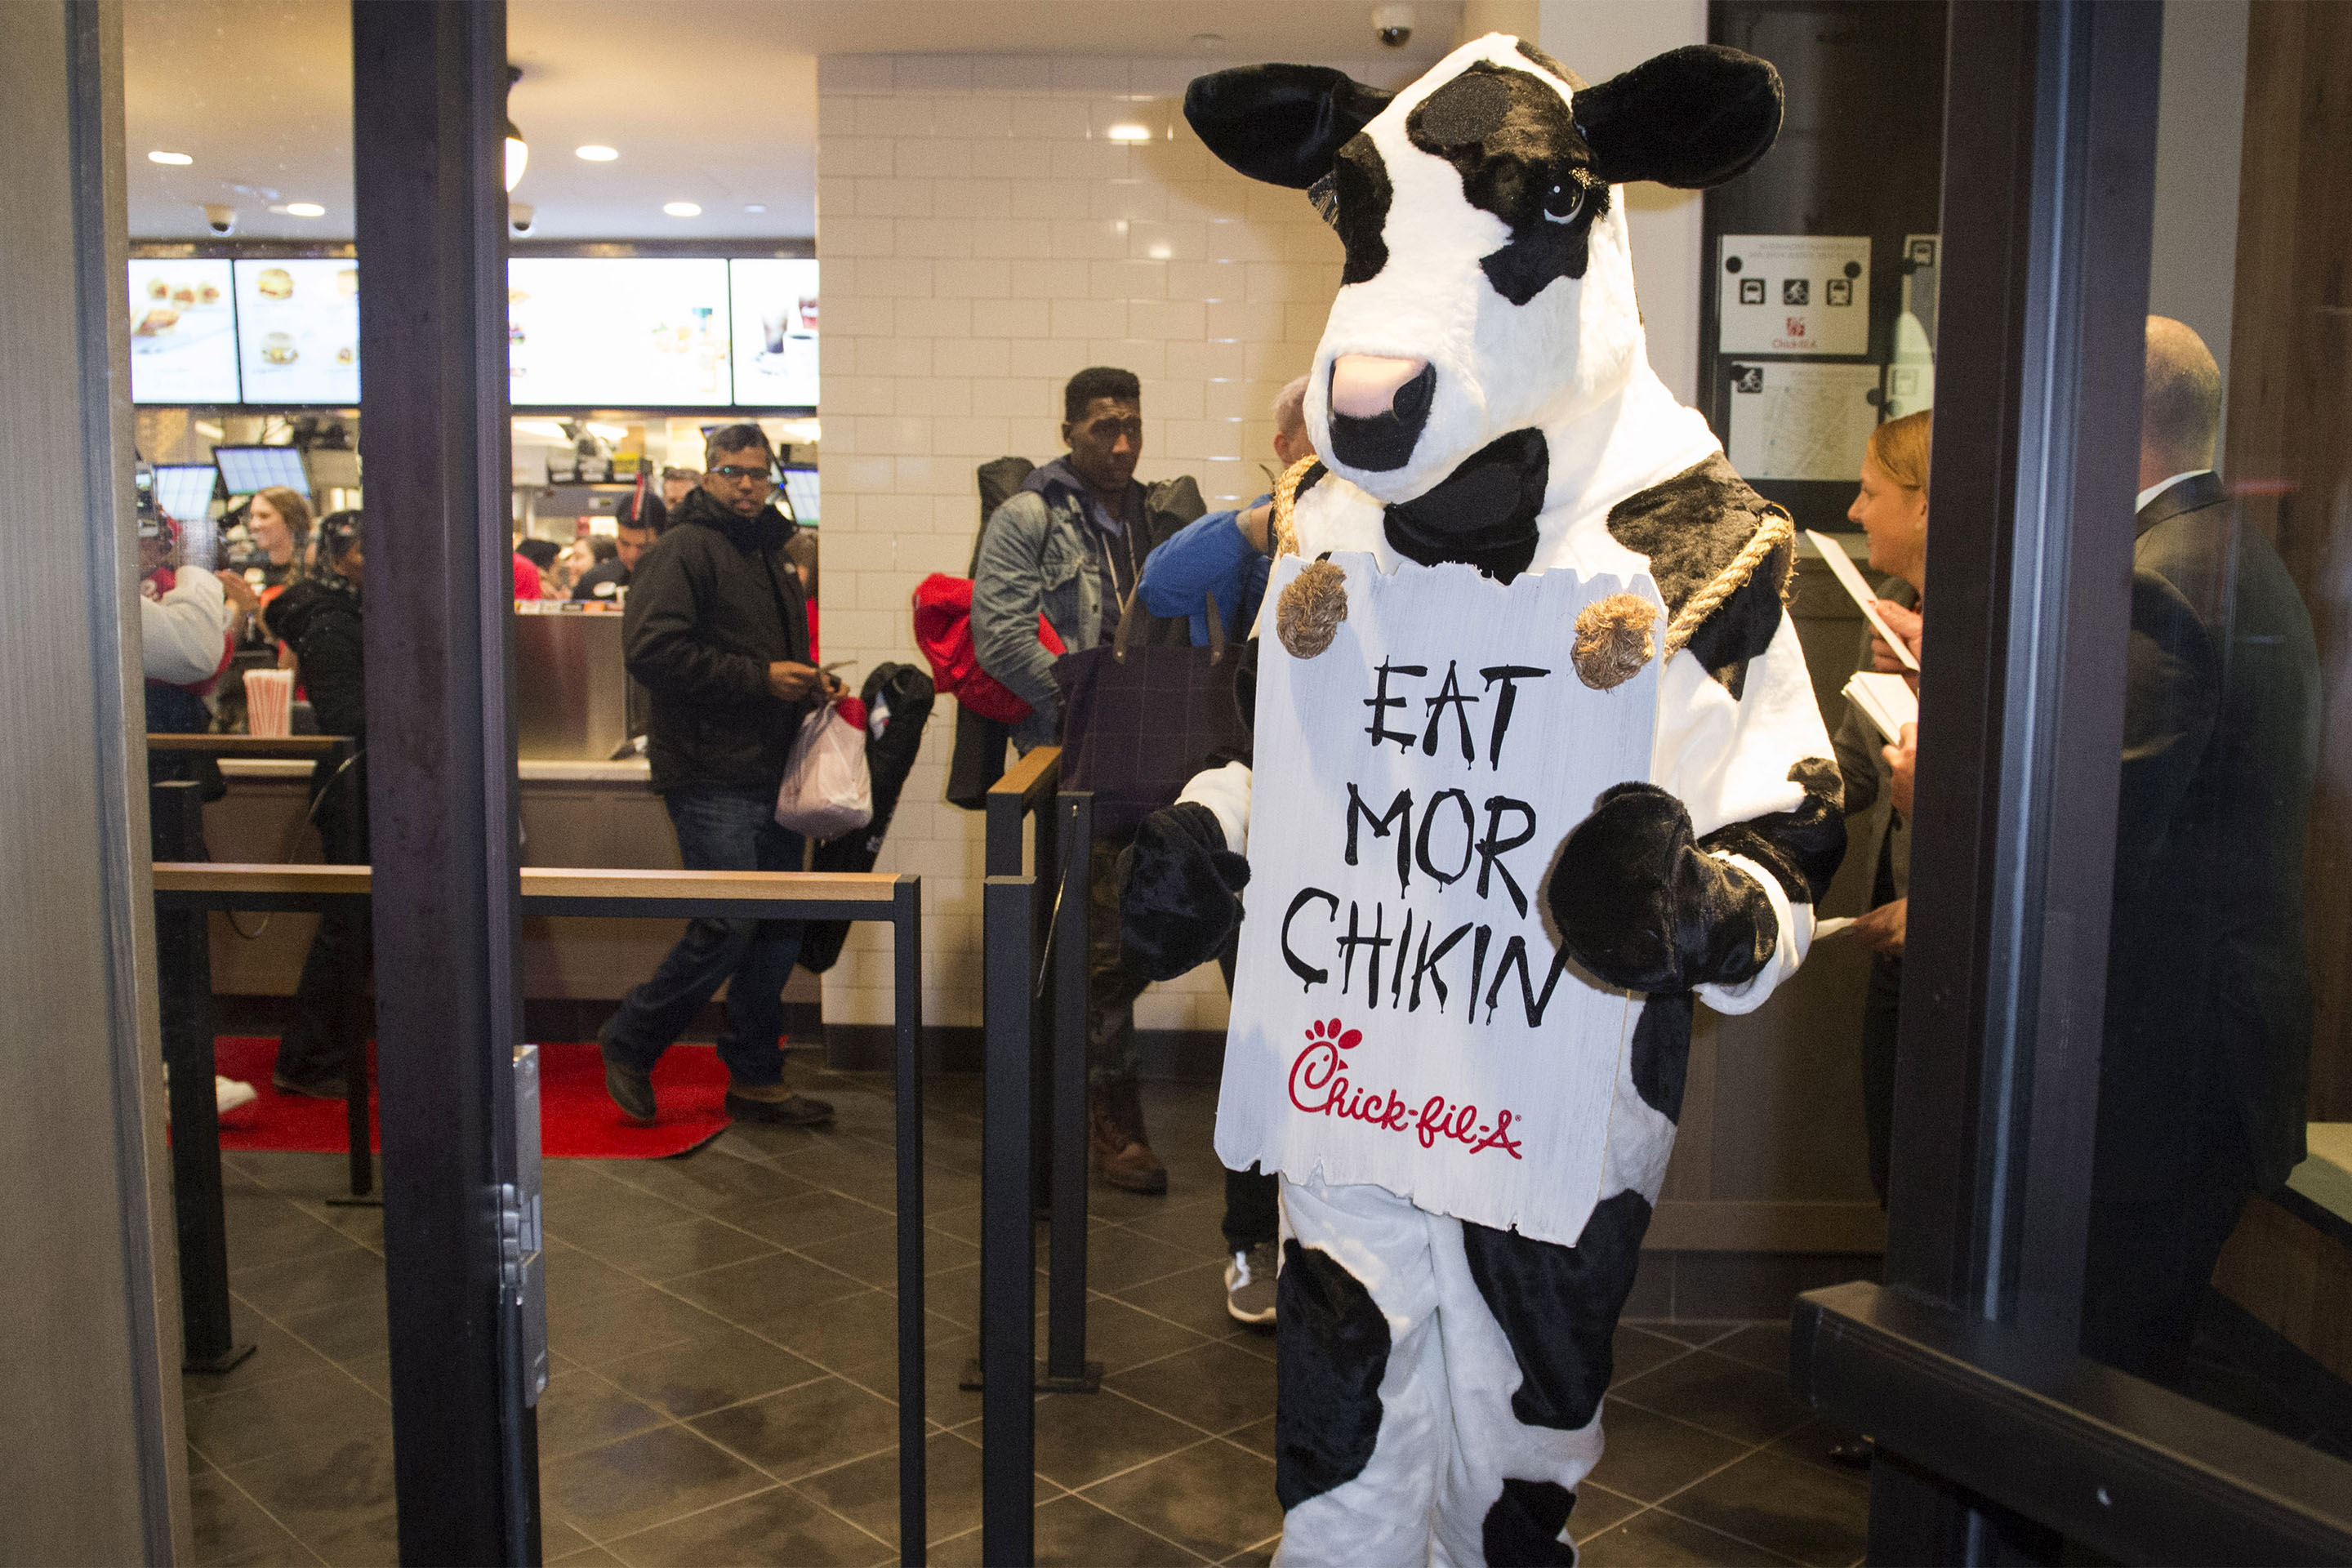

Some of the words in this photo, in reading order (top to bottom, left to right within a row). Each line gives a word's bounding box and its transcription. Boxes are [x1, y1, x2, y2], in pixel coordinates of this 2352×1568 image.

[1363, 654, 1551, 772] EAT
[1345, 782, 1536, 920] MOR
[1281, 887, 1569, 1027] CHIKIN
